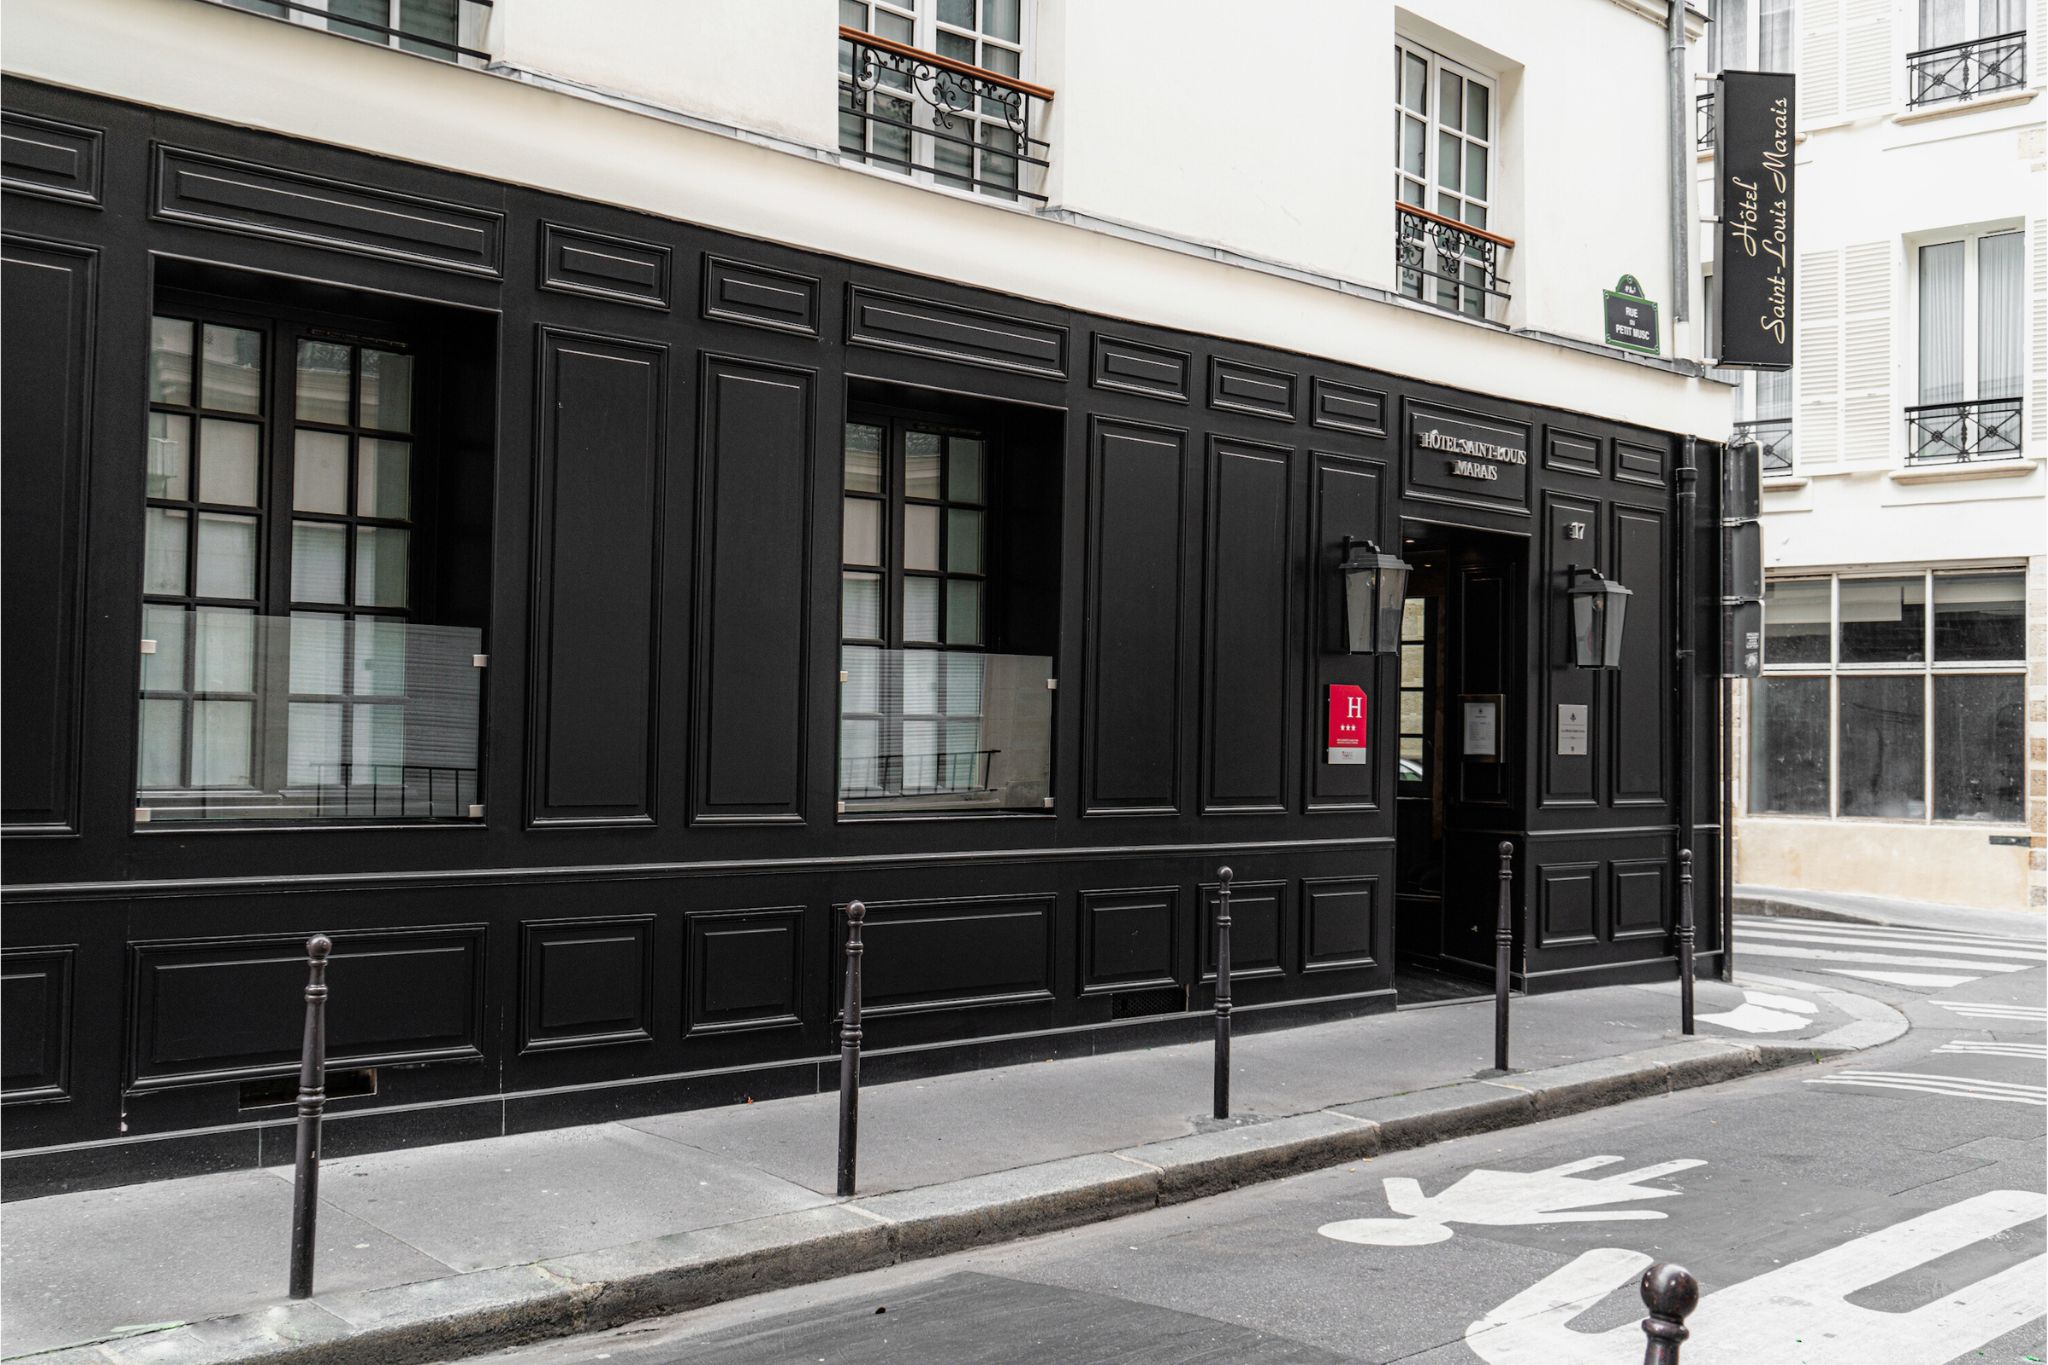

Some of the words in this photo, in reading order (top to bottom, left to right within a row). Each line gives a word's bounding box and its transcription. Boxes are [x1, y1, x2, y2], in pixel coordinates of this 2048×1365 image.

[1762, 96, 1788, 194] Marais
[1729, 176, 1757, 257] Hôtel
[1760, 199, 1787, 344] Saint-Louis
[1625, 306, 1638, 318] RUE
[1615, 323, 1632, 336] PETIT
[1632, 327, 1650, 340] MUSC
[1420, 429, 1460, 453] HÔTEL
[1459, 439, 1527, 465] SAINT-LOUIS
[1453, 460, 1498, 481] MARAIS
[1570, 521, 1586, 540] 17
[1346, 696, 1363, 719] H
